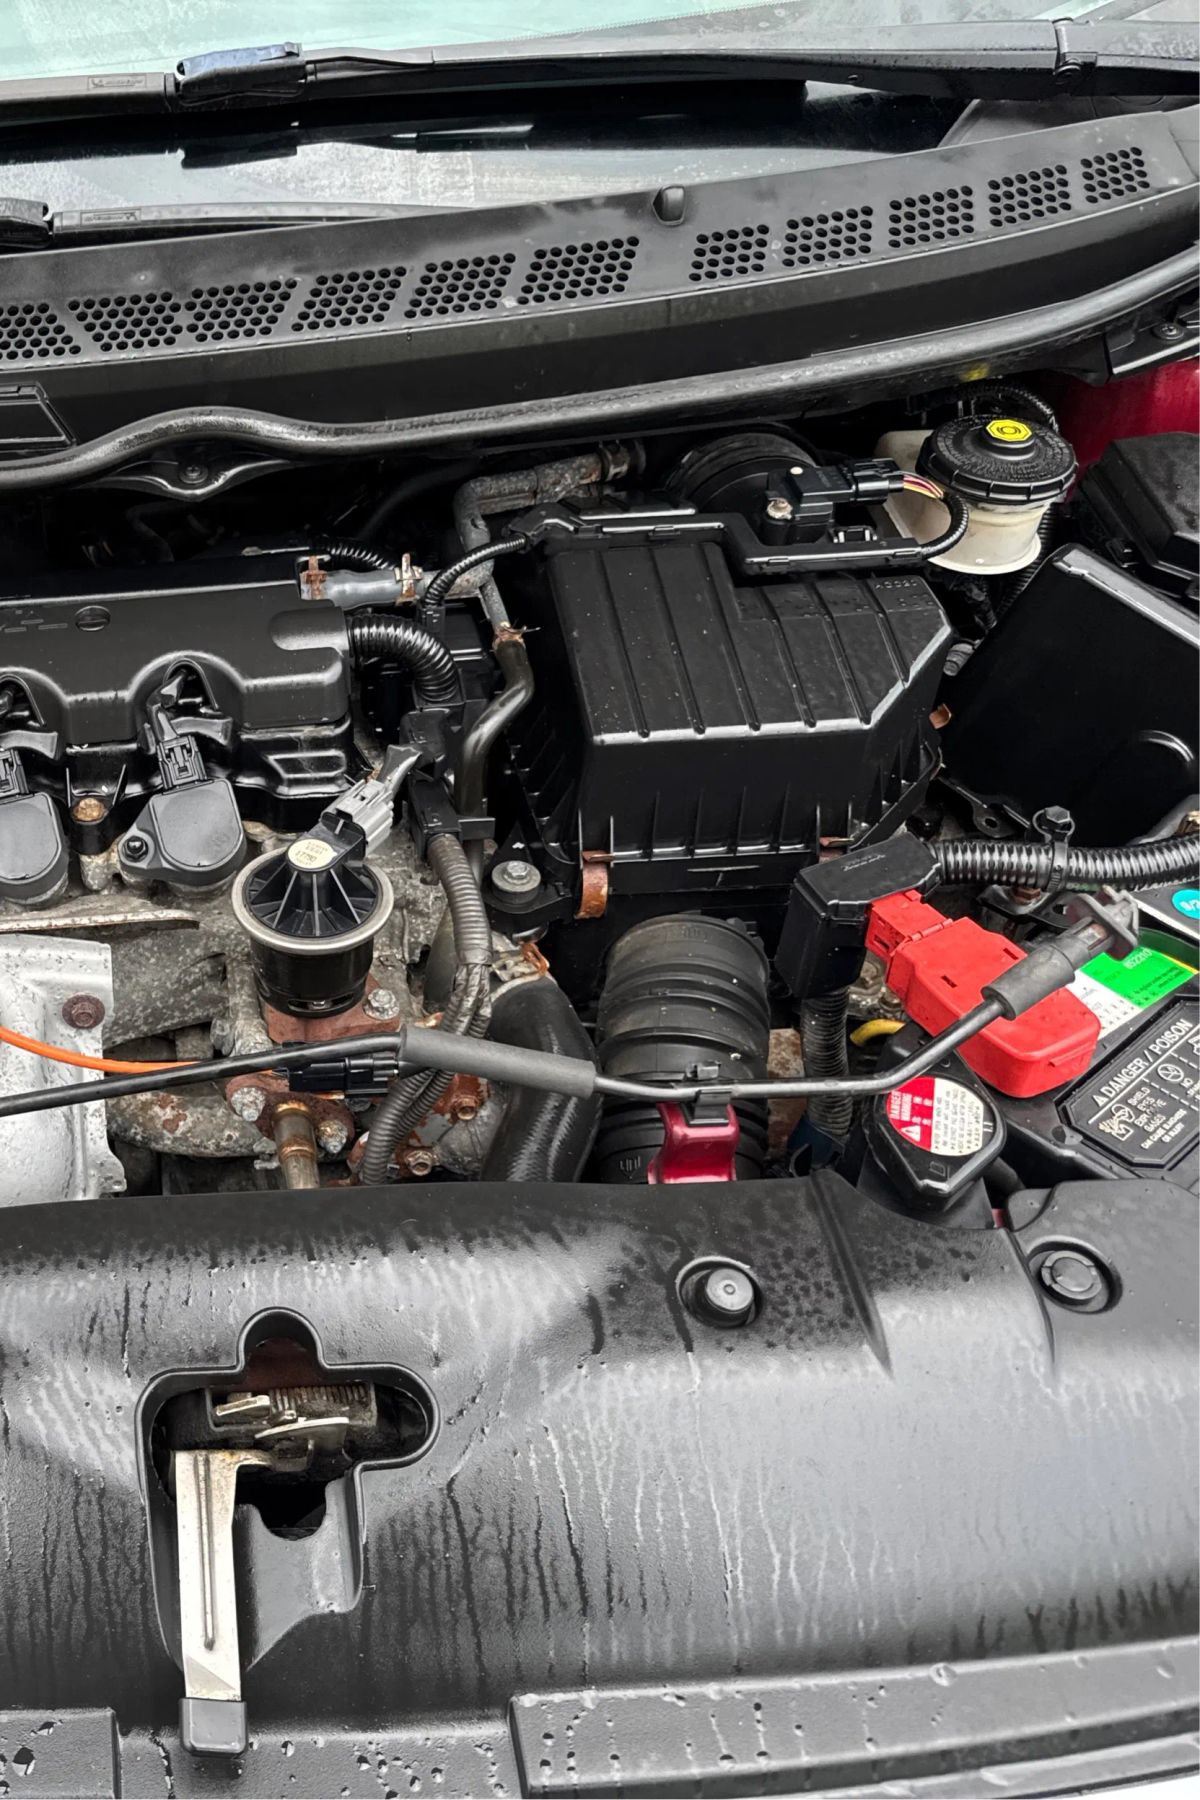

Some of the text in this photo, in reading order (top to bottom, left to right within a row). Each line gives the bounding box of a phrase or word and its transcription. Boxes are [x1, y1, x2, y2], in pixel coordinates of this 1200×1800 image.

[1101, 1058, 1149, 1098] DANGER
[1150, 1017, 1193, 1056] POISON
[1127, 1086, 1151, 1107] SHIELD
[1137, 1096, 1156, 1111] EYES
[1144, 1113, 1167, 1132] GASES
